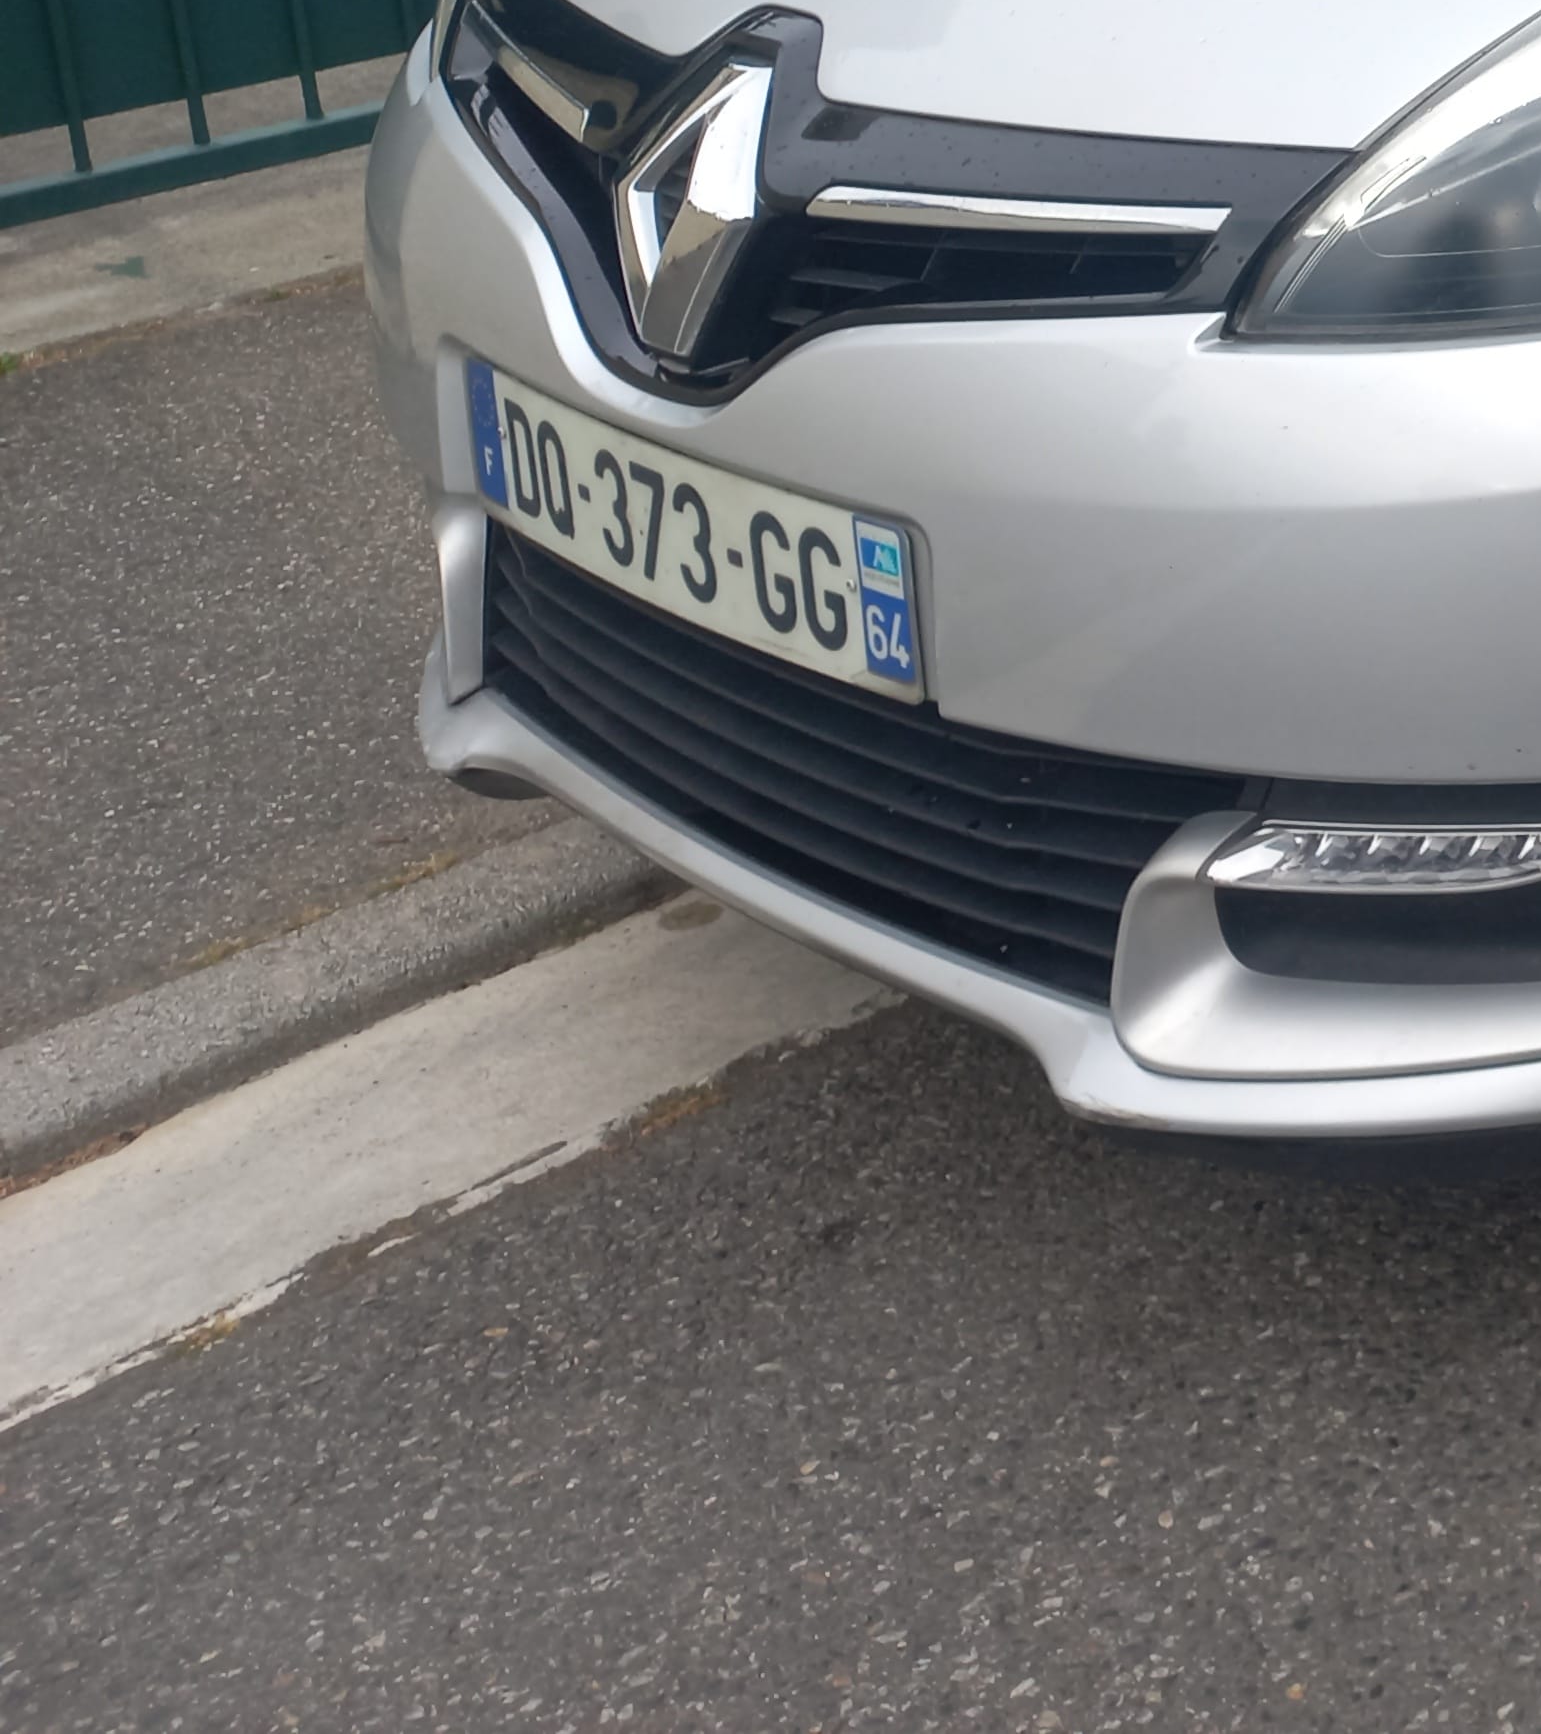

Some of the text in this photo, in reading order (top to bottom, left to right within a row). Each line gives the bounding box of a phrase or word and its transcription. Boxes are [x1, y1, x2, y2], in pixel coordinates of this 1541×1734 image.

[484, 445, 493, 476] F
[504, 398, 848, 651] DQ-373-GG
[866, 604, 910, 669] 64
